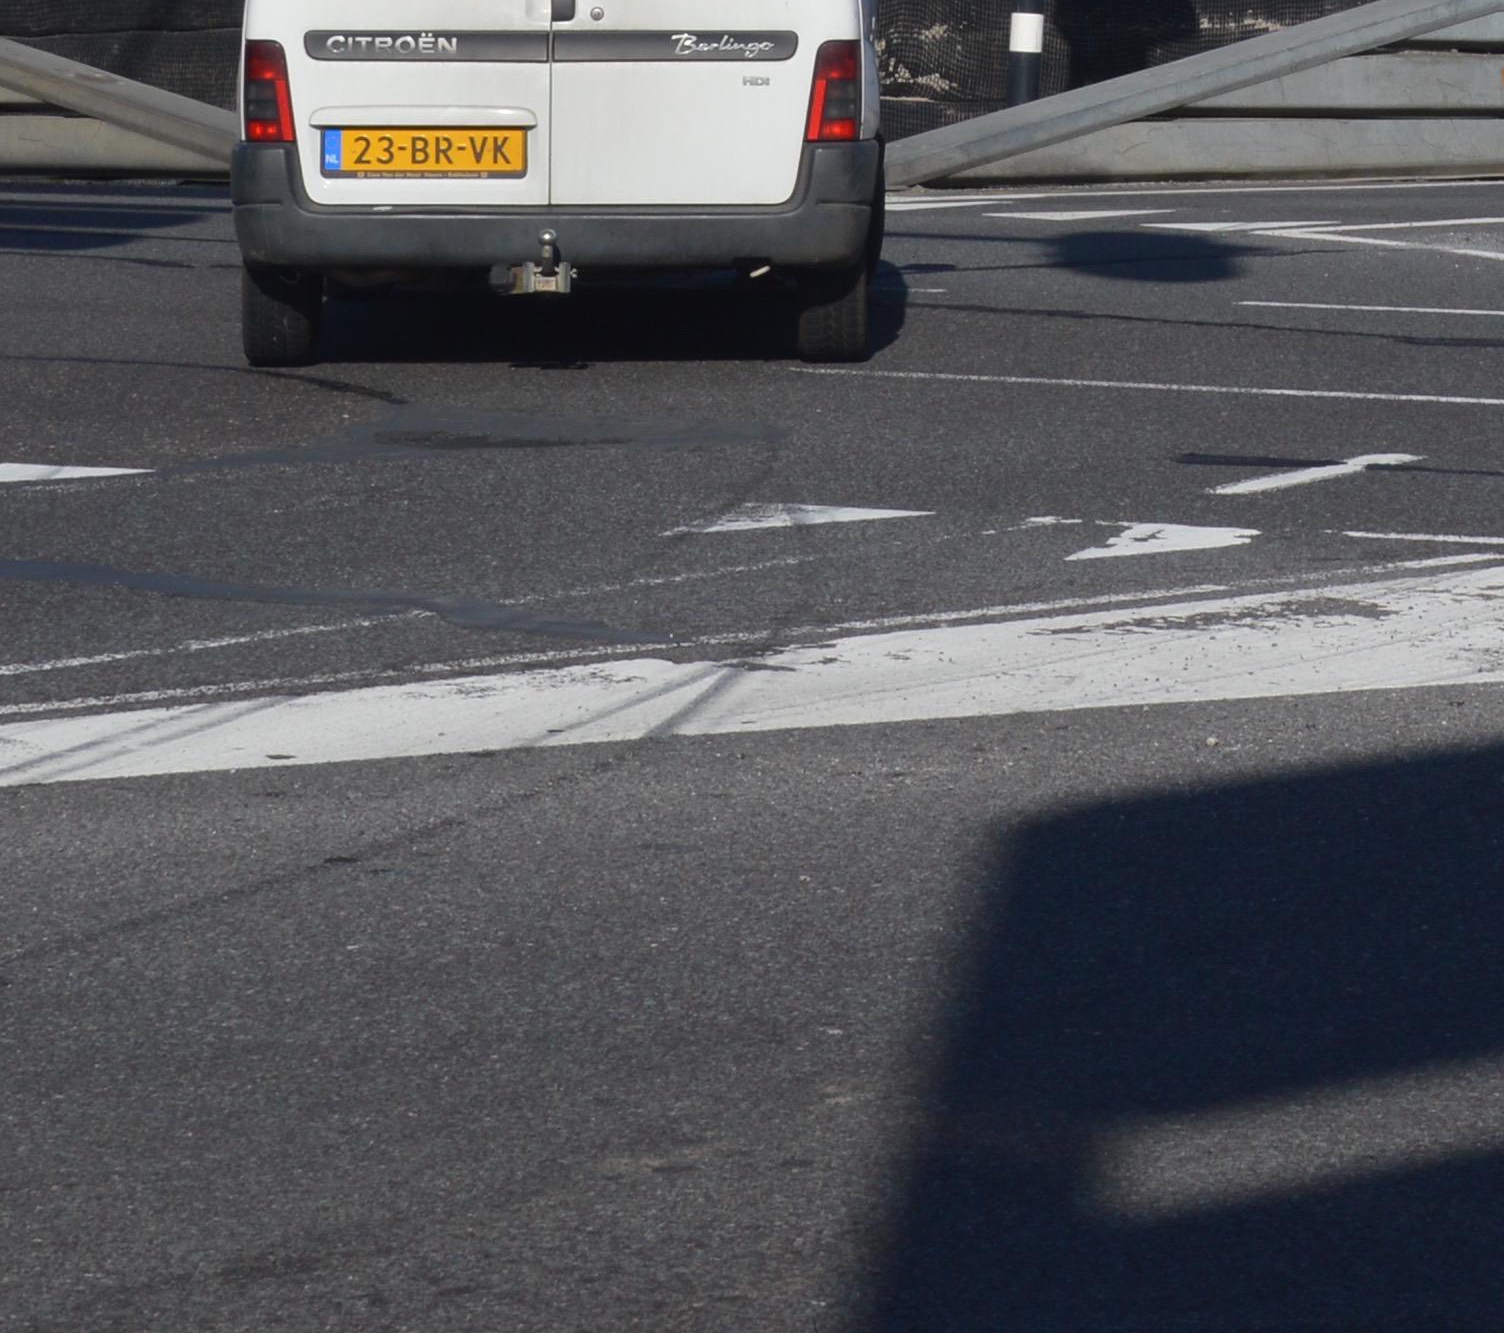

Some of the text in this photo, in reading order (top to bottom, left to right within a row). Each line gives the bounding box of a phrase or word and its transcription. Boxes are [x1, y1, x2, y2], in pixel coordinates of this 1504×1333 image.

[326, 32, 775, 58] CITROËN Berlingo
[325, 136, 512, 165] NL 23-BR-VK
